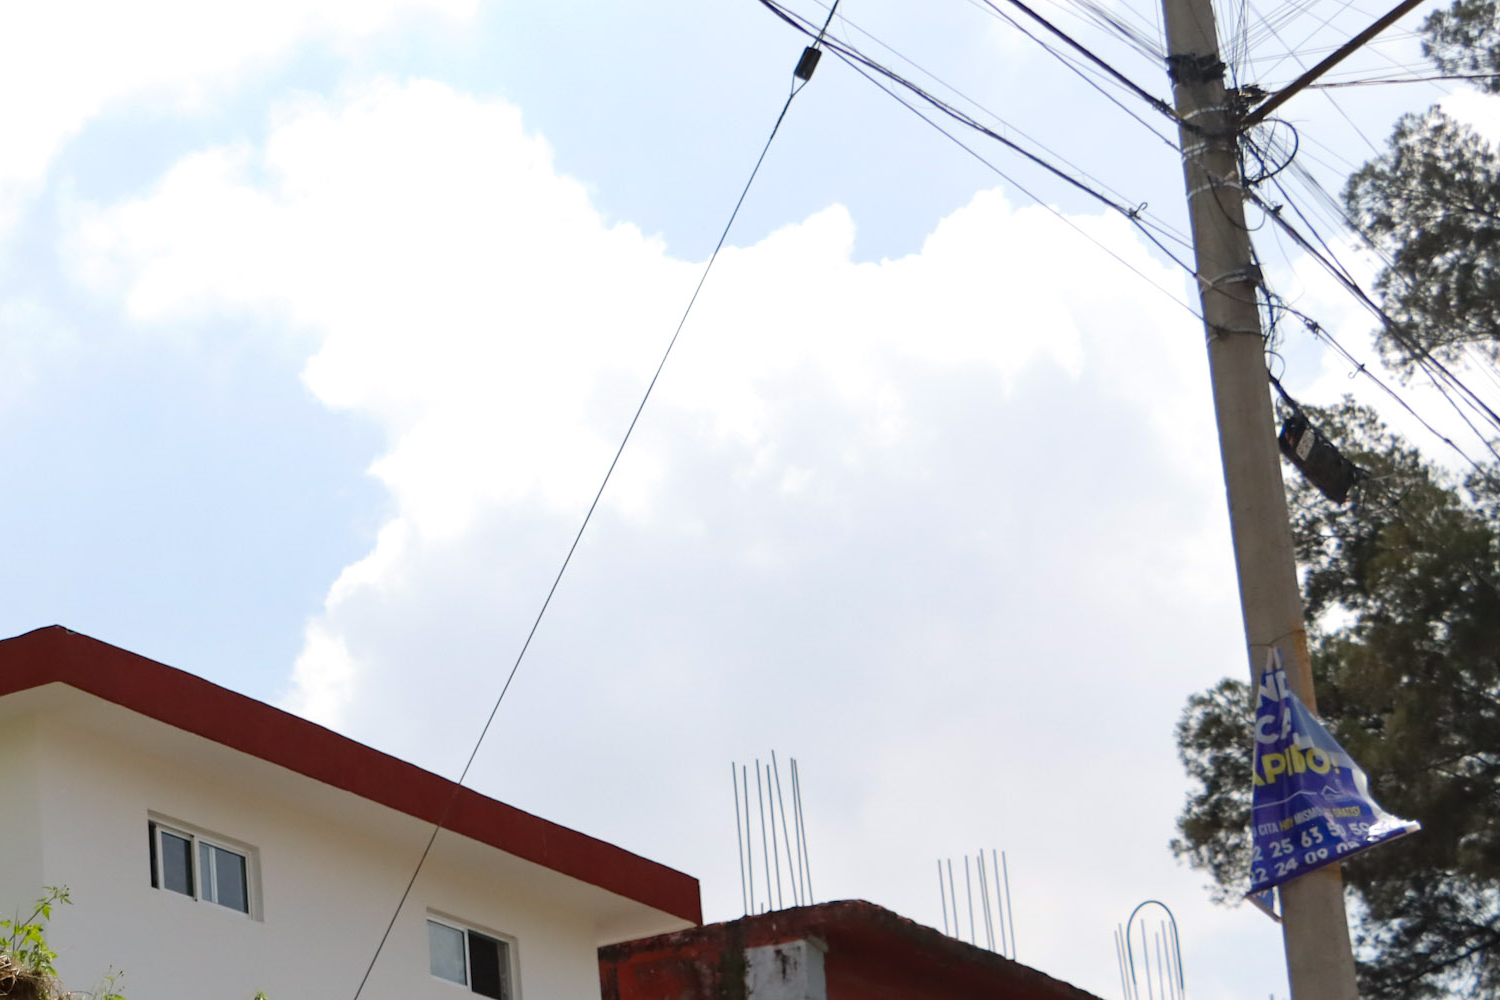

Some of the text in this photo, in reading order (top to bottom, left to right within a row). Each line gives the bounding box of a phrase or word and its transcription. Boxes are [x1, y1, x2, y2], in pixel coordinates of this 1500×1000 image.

[1258, 822, 1278, 836] CITA
[1269, 838, 1294, 858] 25
[1301, 826, 1324, 848] 63
[1275, 857, 1298, 876] 24
